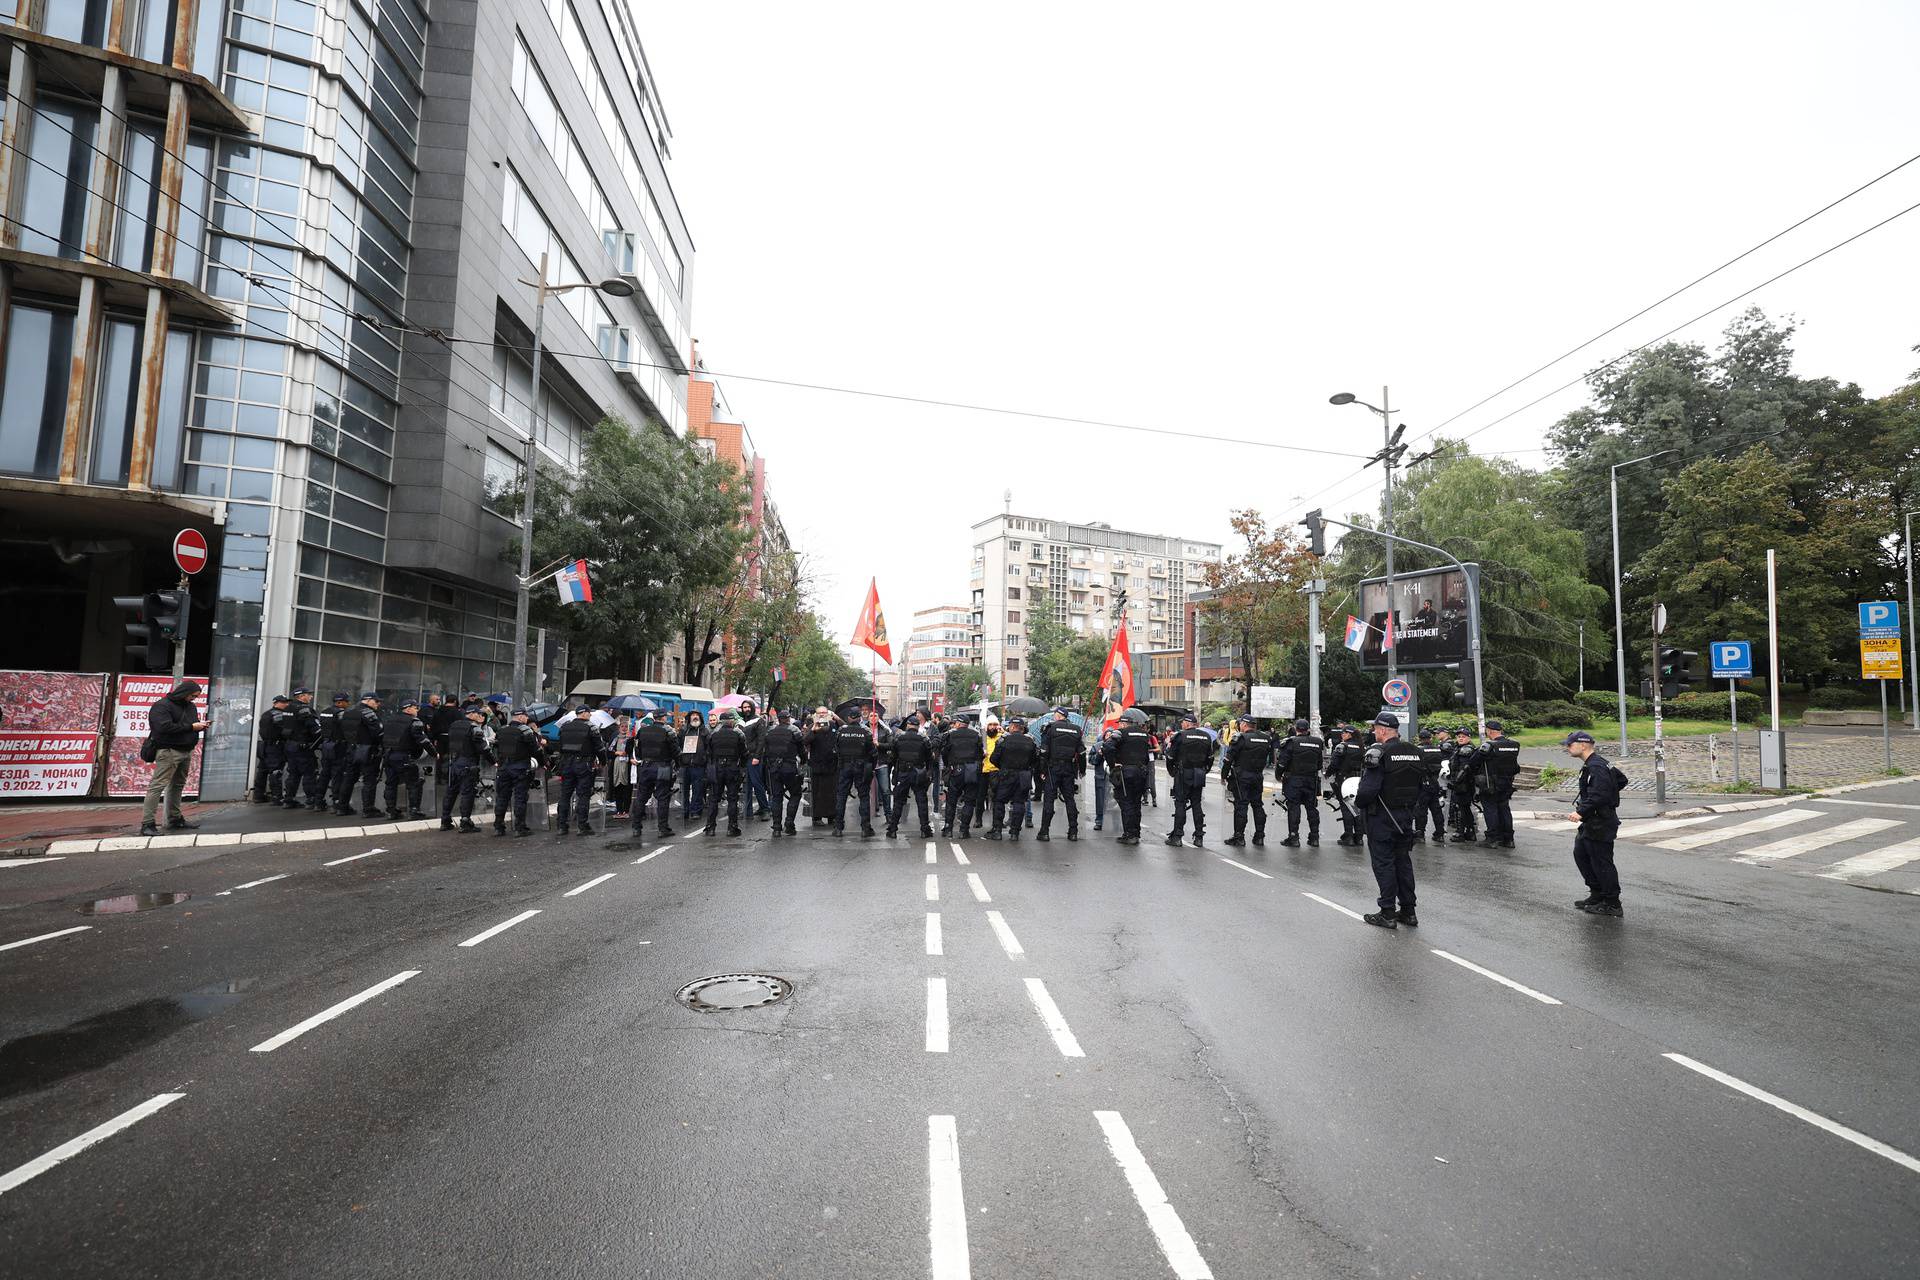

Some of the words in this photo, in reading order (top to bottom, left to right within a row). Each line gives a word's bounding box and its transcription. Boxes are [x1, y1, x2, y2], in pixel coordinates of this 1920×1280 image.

[1868, 605, 1889, 625] P
[1407, 627, 1439, 638] STATEMENT
[1721, 646, 1741, 666] P
[124, 682, 173, 694] ПОНЕСИ
[129, 721, 150, 731] 8.9.
[41, 739, 93, 751] БАРЈАК
[42, 768, 88, 779] МОНАКО
[56, 780, 68, 790] 21
